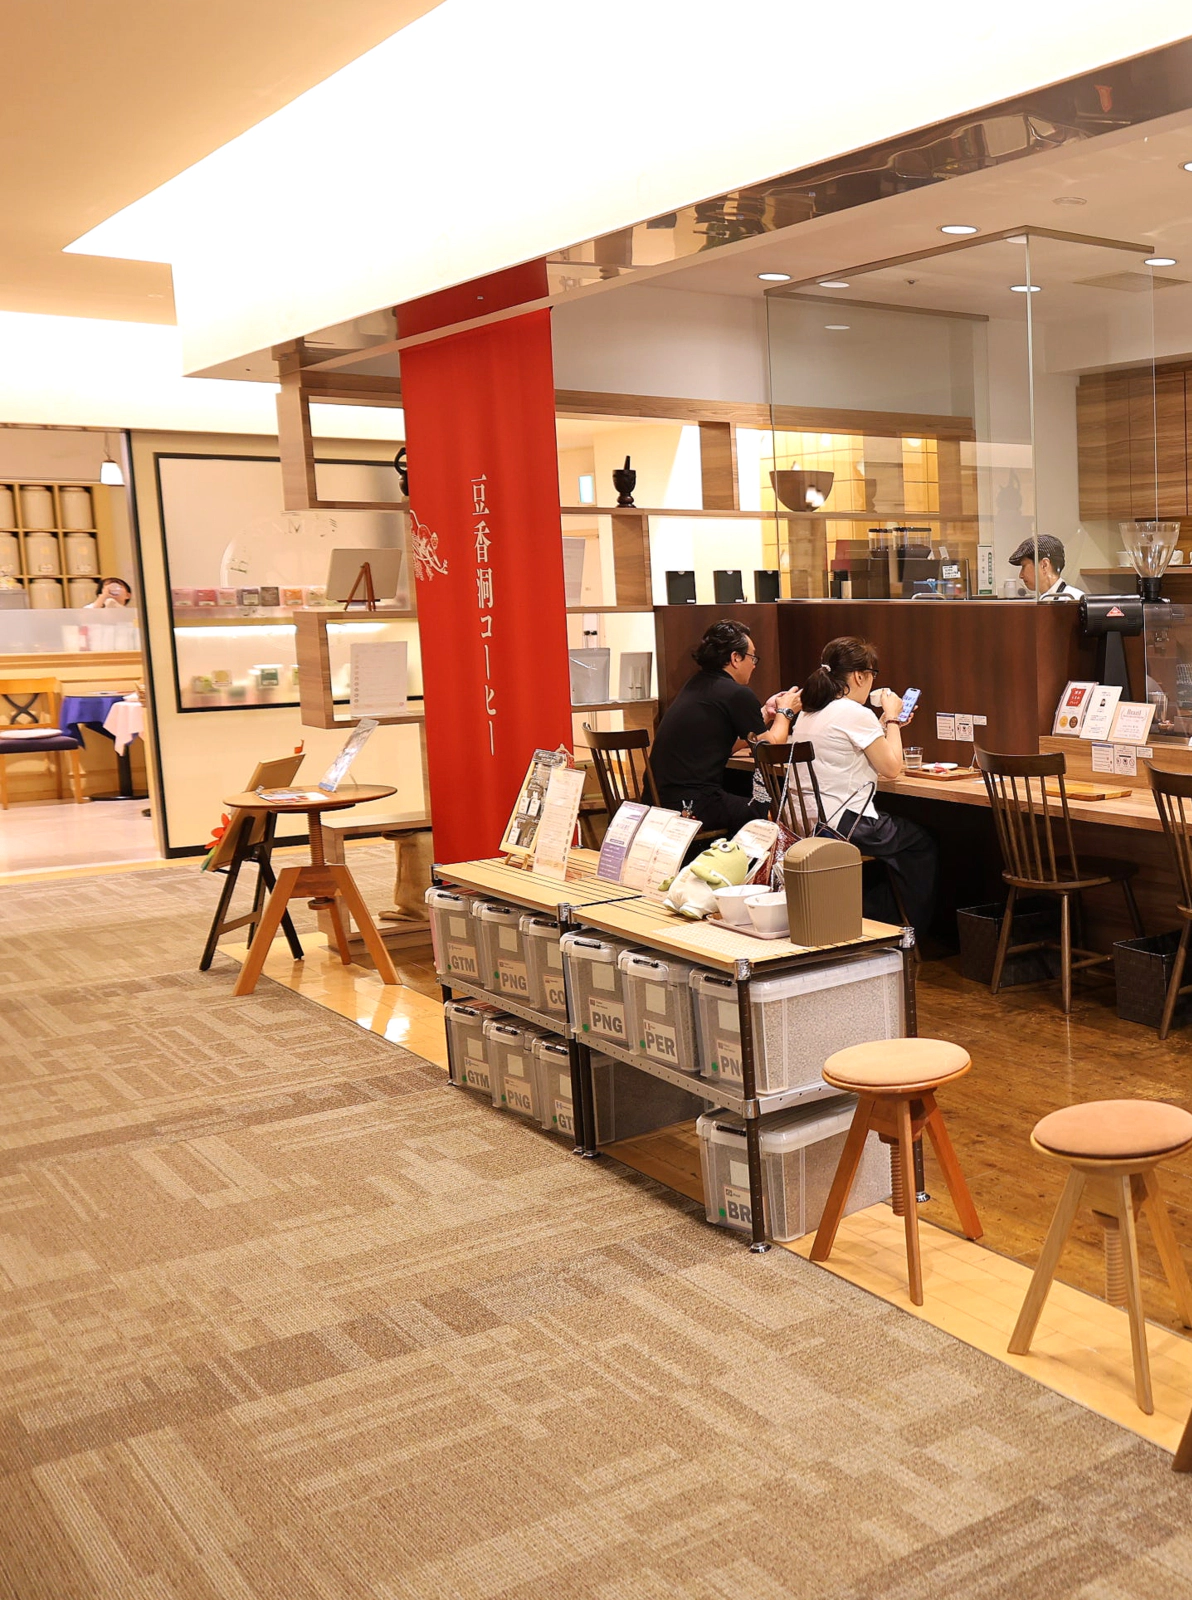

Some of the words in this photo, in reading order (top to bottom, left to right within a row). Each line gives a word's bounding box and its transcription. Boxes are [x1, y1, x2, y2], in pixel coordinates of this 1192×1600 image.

[470, 473, 497, 756] 豆香洞コーヒー
[451, 954, 475, 973] GTM
[501, 971, 527, 991] PNG
[592, 1011, 623, 1034] PNG
[645, 1031, 676, 1057] PER
[720, 1055, 743, 1078] PN
[467, 1069, 490, 1089] GTM
[507, 1089, 531, 1110] PNG
